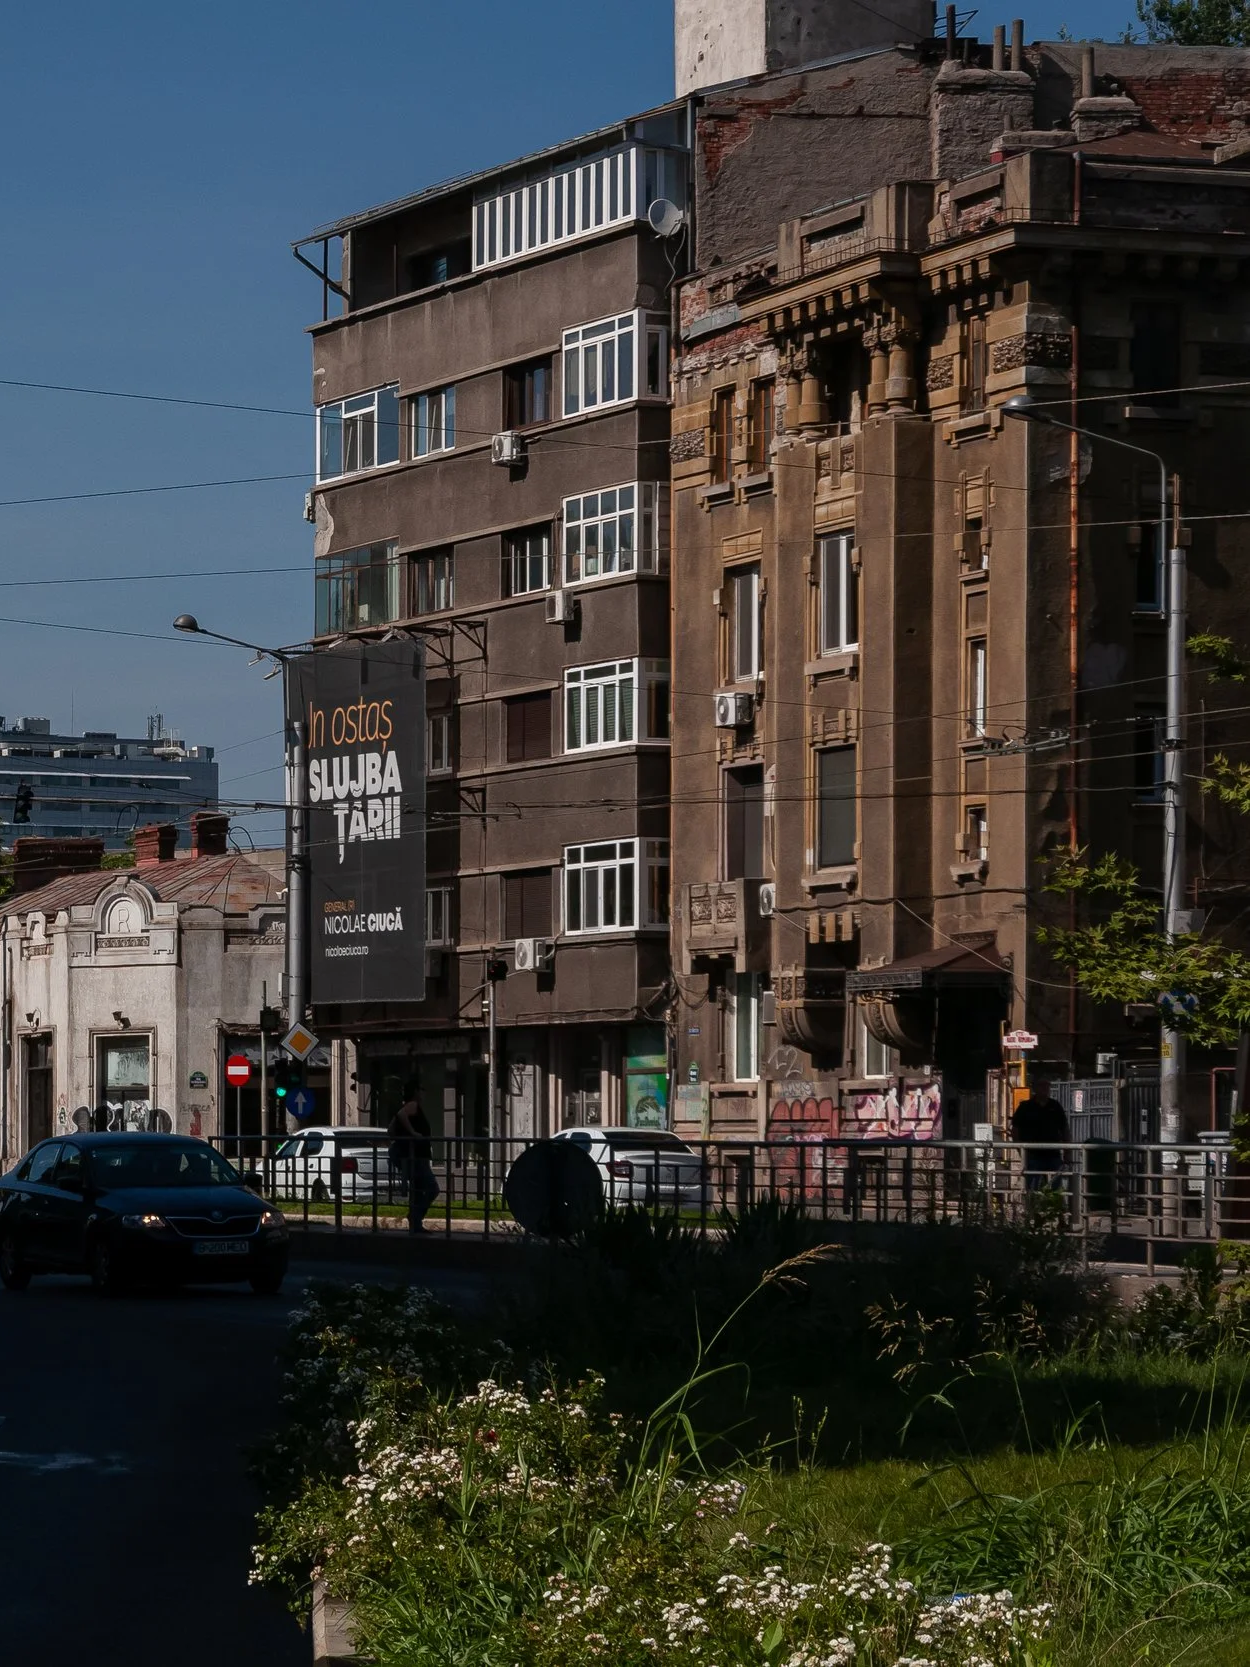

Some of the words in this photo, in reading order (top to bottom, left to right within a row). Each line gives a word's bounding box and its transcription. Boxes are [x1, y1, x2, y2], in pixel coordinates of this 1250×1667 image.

[331, 696, 393, 755] ostaș
[309, 750, 402, 802] SLUJBA
[324, 913, 366, 935] NICOLAE
[367, 906, 404, 932] CIUCĂ
[325, 944, 369, 957] nicolaeciuca.ro
